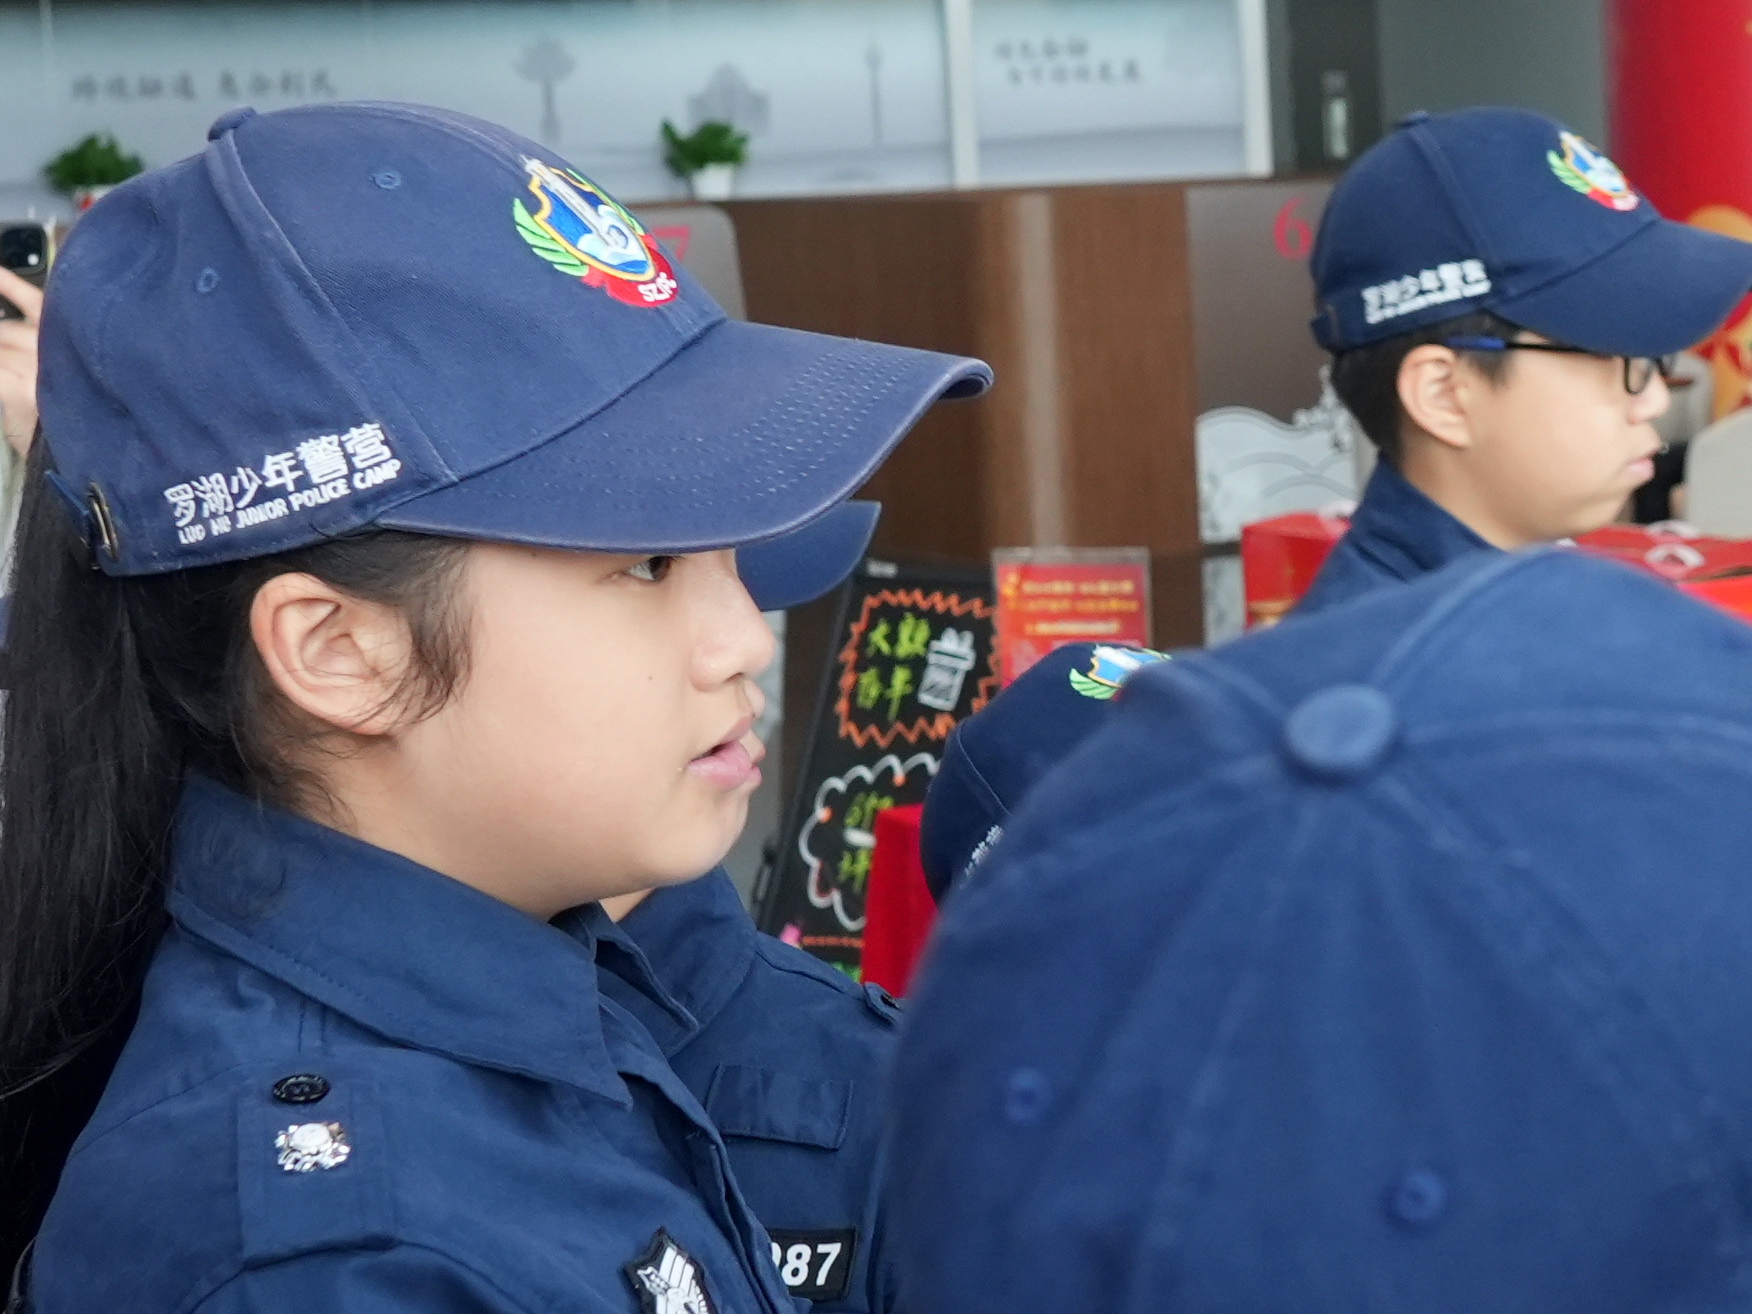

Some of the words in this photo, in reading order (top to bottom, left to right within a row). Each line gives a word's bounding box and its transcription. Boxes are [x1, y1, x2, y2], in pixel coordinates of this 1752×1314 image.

[1274, 197, 1313, 261] 6
[163, 422, 393, 528] 罗湖少年警营
[236, 497, 289, 529] JUNIOR
[288, 478, 351, 512] POLICE
[352, 459, 402, 490] CAMP
